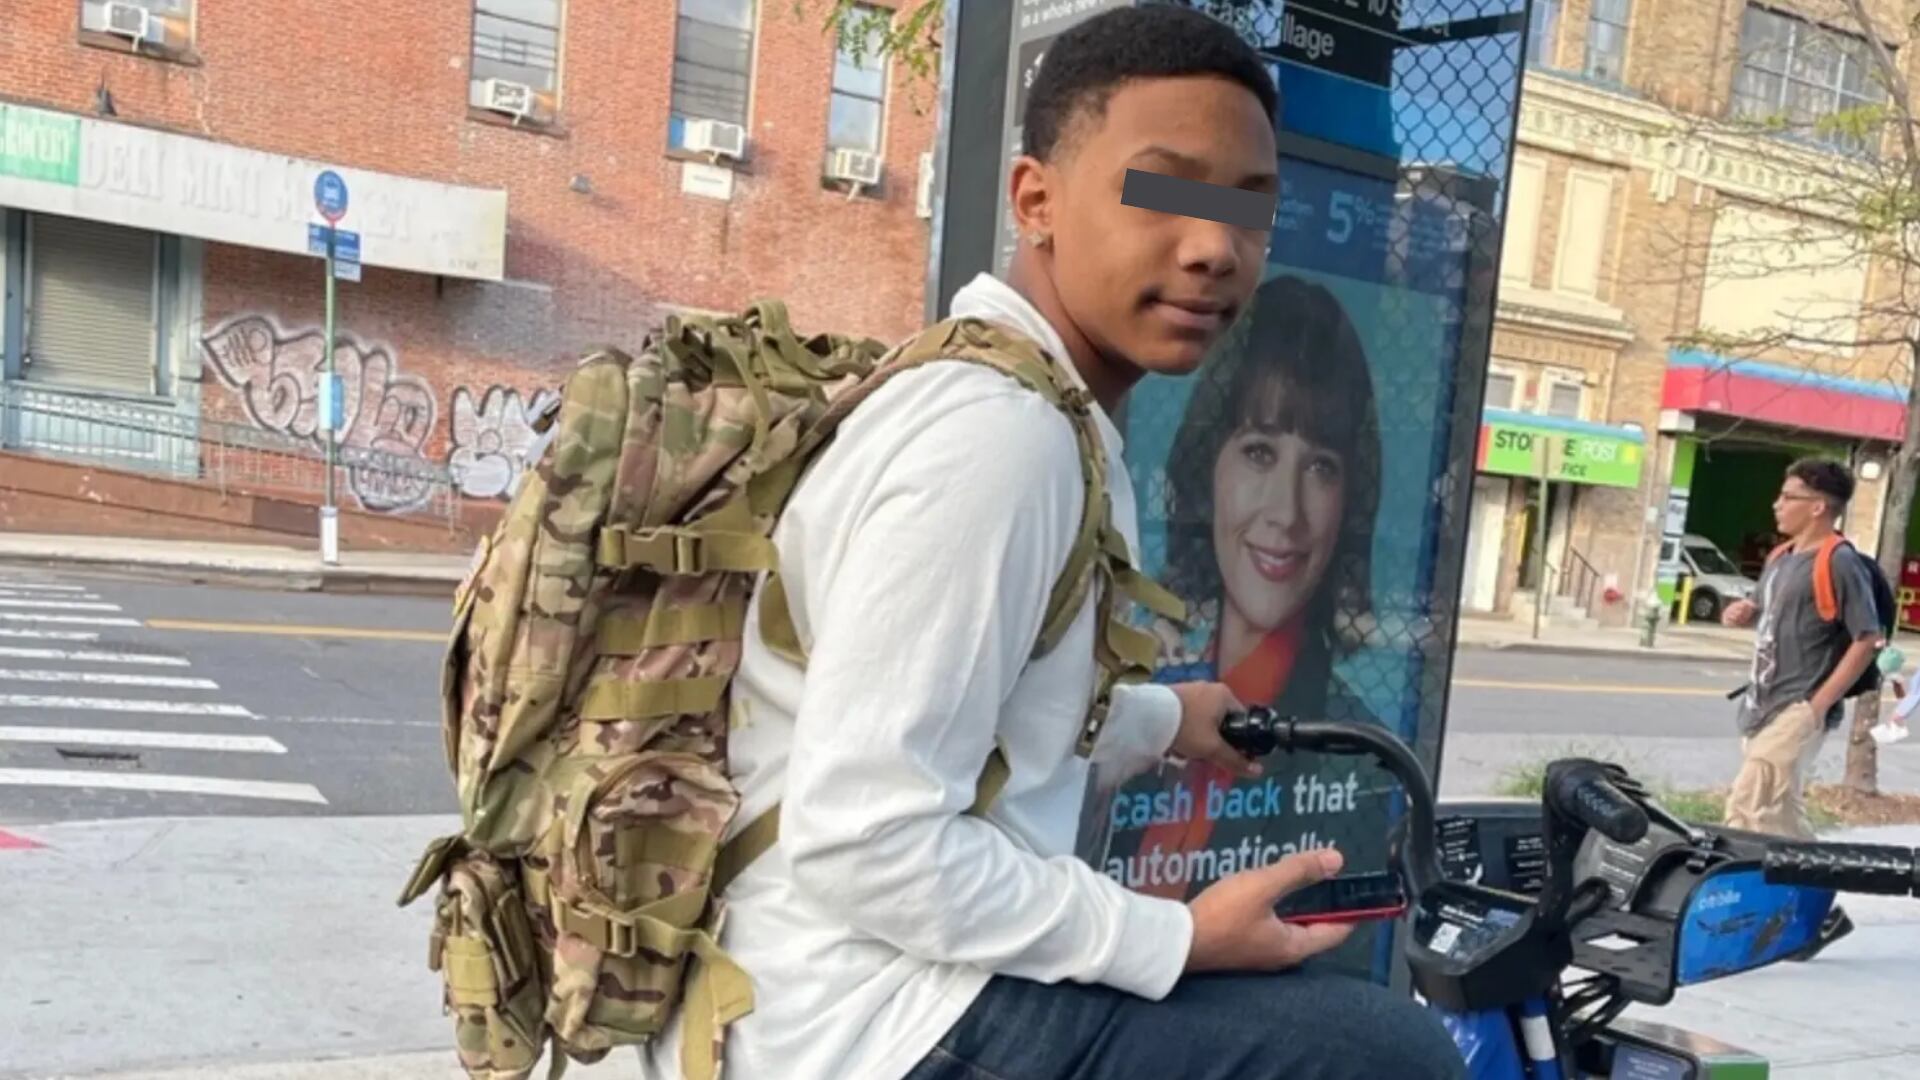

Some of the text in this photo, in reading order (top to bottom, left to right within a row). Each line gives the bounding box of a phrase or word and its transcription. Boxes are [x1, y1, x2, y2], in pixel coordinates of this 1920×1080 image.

[1282, 12, 1335, 60] llage
[1560, 462, 1589, 477] FICE
[1110, 771, 1359, 828] cash back that
[1105, 830, 1337, 888] automaticll
